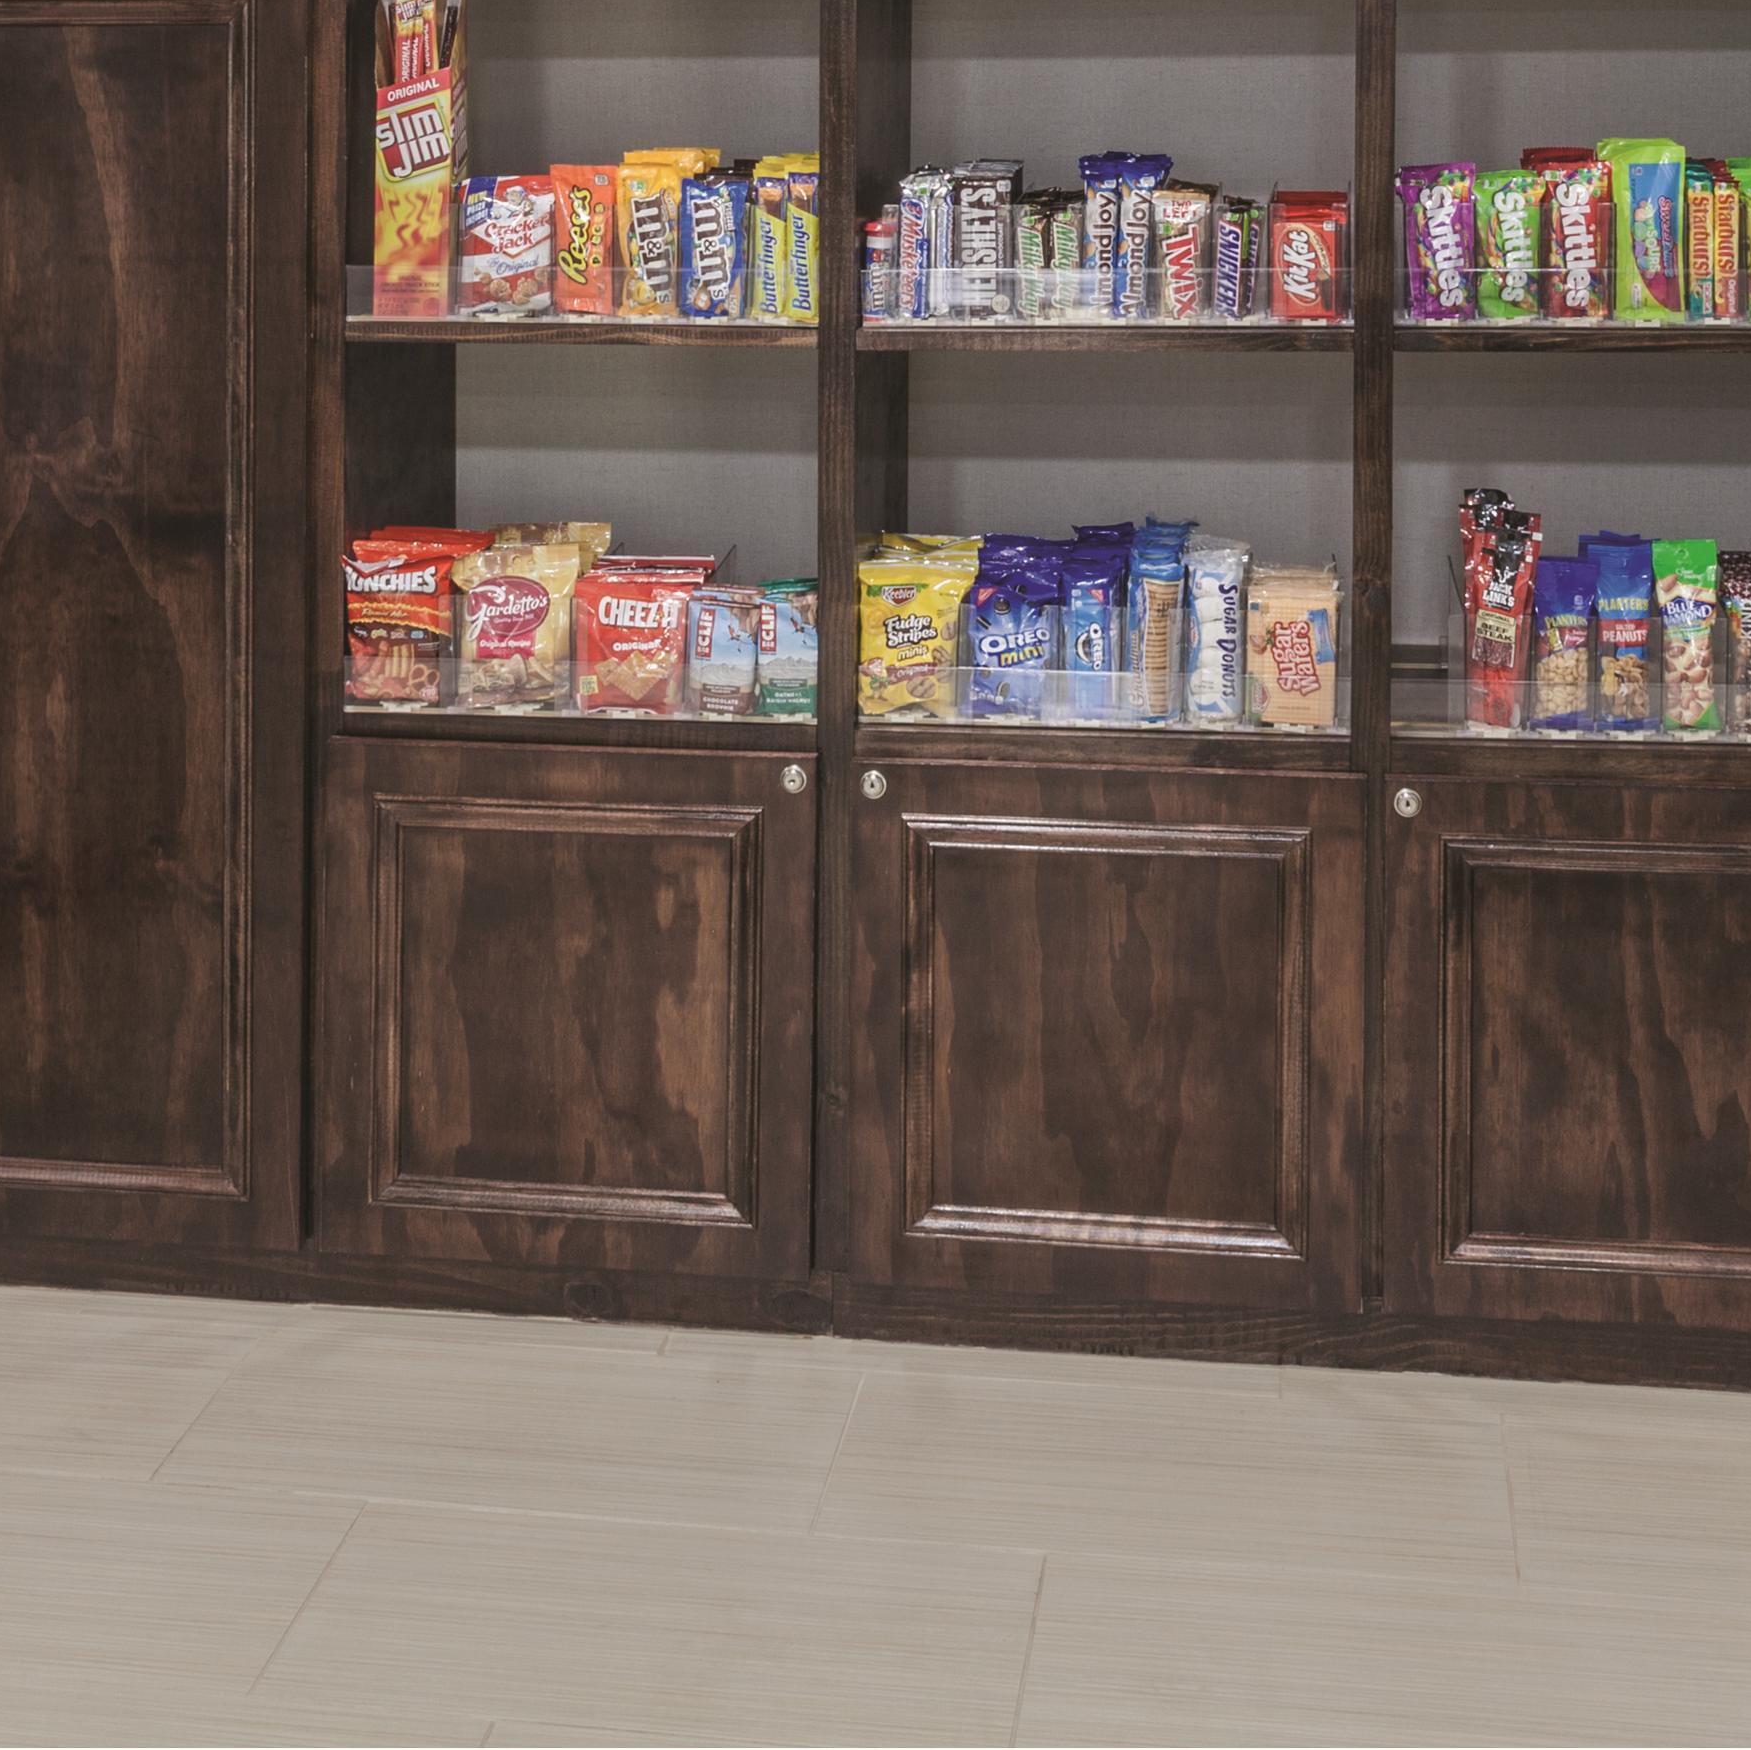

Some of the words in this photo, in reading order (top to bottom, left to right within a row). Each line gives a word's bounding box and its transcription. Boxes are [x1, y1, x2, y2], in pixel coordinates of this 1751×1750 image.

[386, 77, 441, 102] ORIGINAL
[376, 106, 444, 149] slim
[392, 130, 450, 179] Jim
[483, 214, 550, 239] Cracker
[1092, 192, 1117, 236] Joy
[1126, 189, 1152, 233] Joy
[1717, 193, 1737, 278] Starburst
[492, 233, 536, 254] Jack
[791, 212, 812, 312] Butterfinger
[961, 186, 998, 307] HERSHEY'S
[1017, 226, 1045, 280] Milky
[1051, 221, 1079, 274] Milky
[1419, 184, 1465, 308] Skittles
[1493, 191, 1534, 303] Skittles
[1555, 182, 1598, 309] Skittles
[1692, 195, 1712, 280] Starburst
[495, 255, 541, 276] Original
[759, 217, 779, 315] Butterfinger
[900, 215, 924, 311] Musketeers
[1089, 234, 1115, 316] Almond
[1119, 232, 1148, 318] Almond
[1162, 223, 1200, 320] TWIX
[1218, 223, 1241, 320] SNICKERS
[1281, 229, 1318, 301] KitKat
[1016, 277, 1046, 316] Way
[467, 584, 549, 641] Gardetto's
[882, 585, 916, 602] Keebler
[1217, 583, 1238, 635] SUGAR
[1599, 597, 1650, 611] PLANTERS
[1667, 600, 1698, 615] BLUE
[697, 608, 714, 647] CLIF
[761, 603, 776, 641] CLIF
[886, 613, 932, 634] Fudge
[886, 628, 938, 648] Stripes
[980, 628, 1050, 655] OREO
[1476, 628, 1514, 643] STEAK
[1481, 620, 1510, 634] BEEF
[1602, 629, 1648, 642] PEANUTS
[896, 644, 929, 662] minis
[999, 645, 1045, 667] mini
[1089, 622, 1106, 672] OREO
[1216, 637, 1237, 699] DONUTS
[1273, 621, 1295, 693] Sugar
[1290, 619, 1321, 697] Wafers
[702, 696, 739, 706] CHOCOLATE
